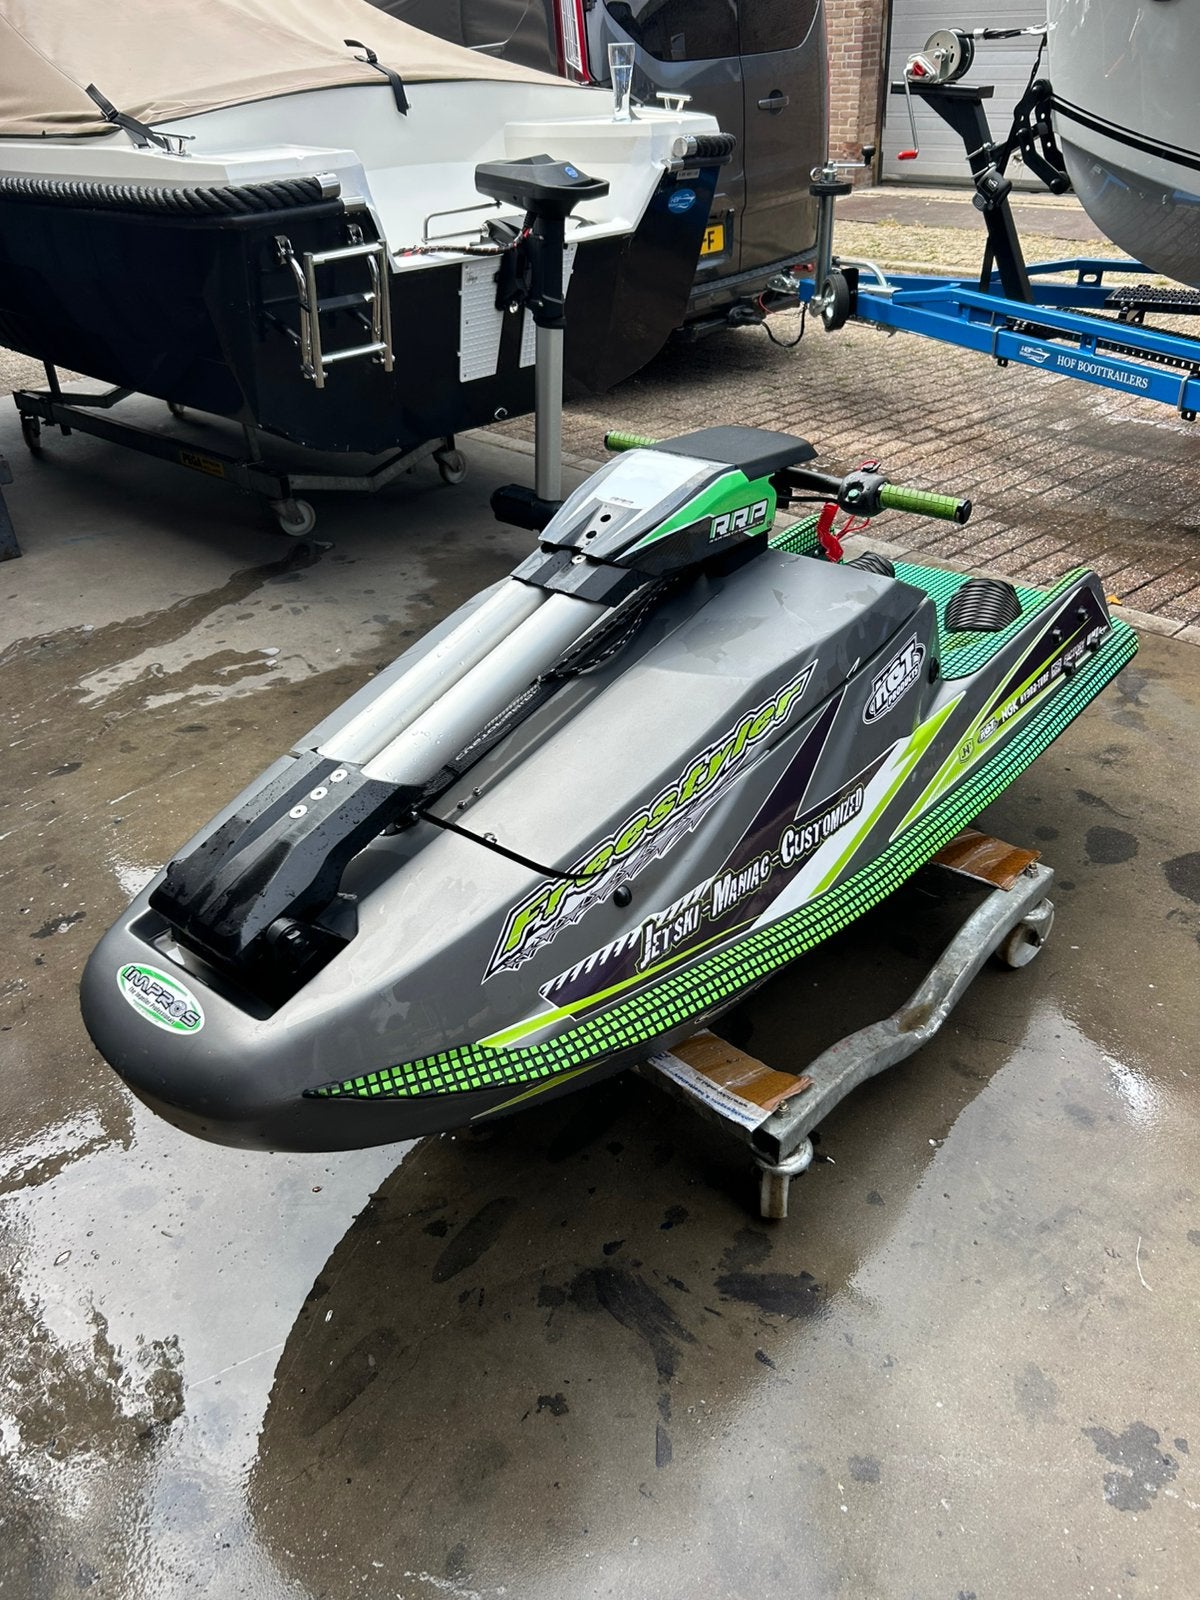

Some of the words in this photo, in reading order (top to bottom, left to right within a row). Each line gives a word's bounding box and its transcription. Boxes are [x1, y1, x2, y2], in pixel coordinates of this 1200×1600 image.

[1057, 355, 1077, 370] HOF
[1077, 359, 1148, 389] BOOTTRAILERS
[709, 499, 768, 539] RRP
[888, 664, 919, 706] PRODUCTS
[1001, 700, 1019, 723] NGK
[503, 682, 802, 953] Freestyler
[123, 965, 200, 1028] IMPROS
